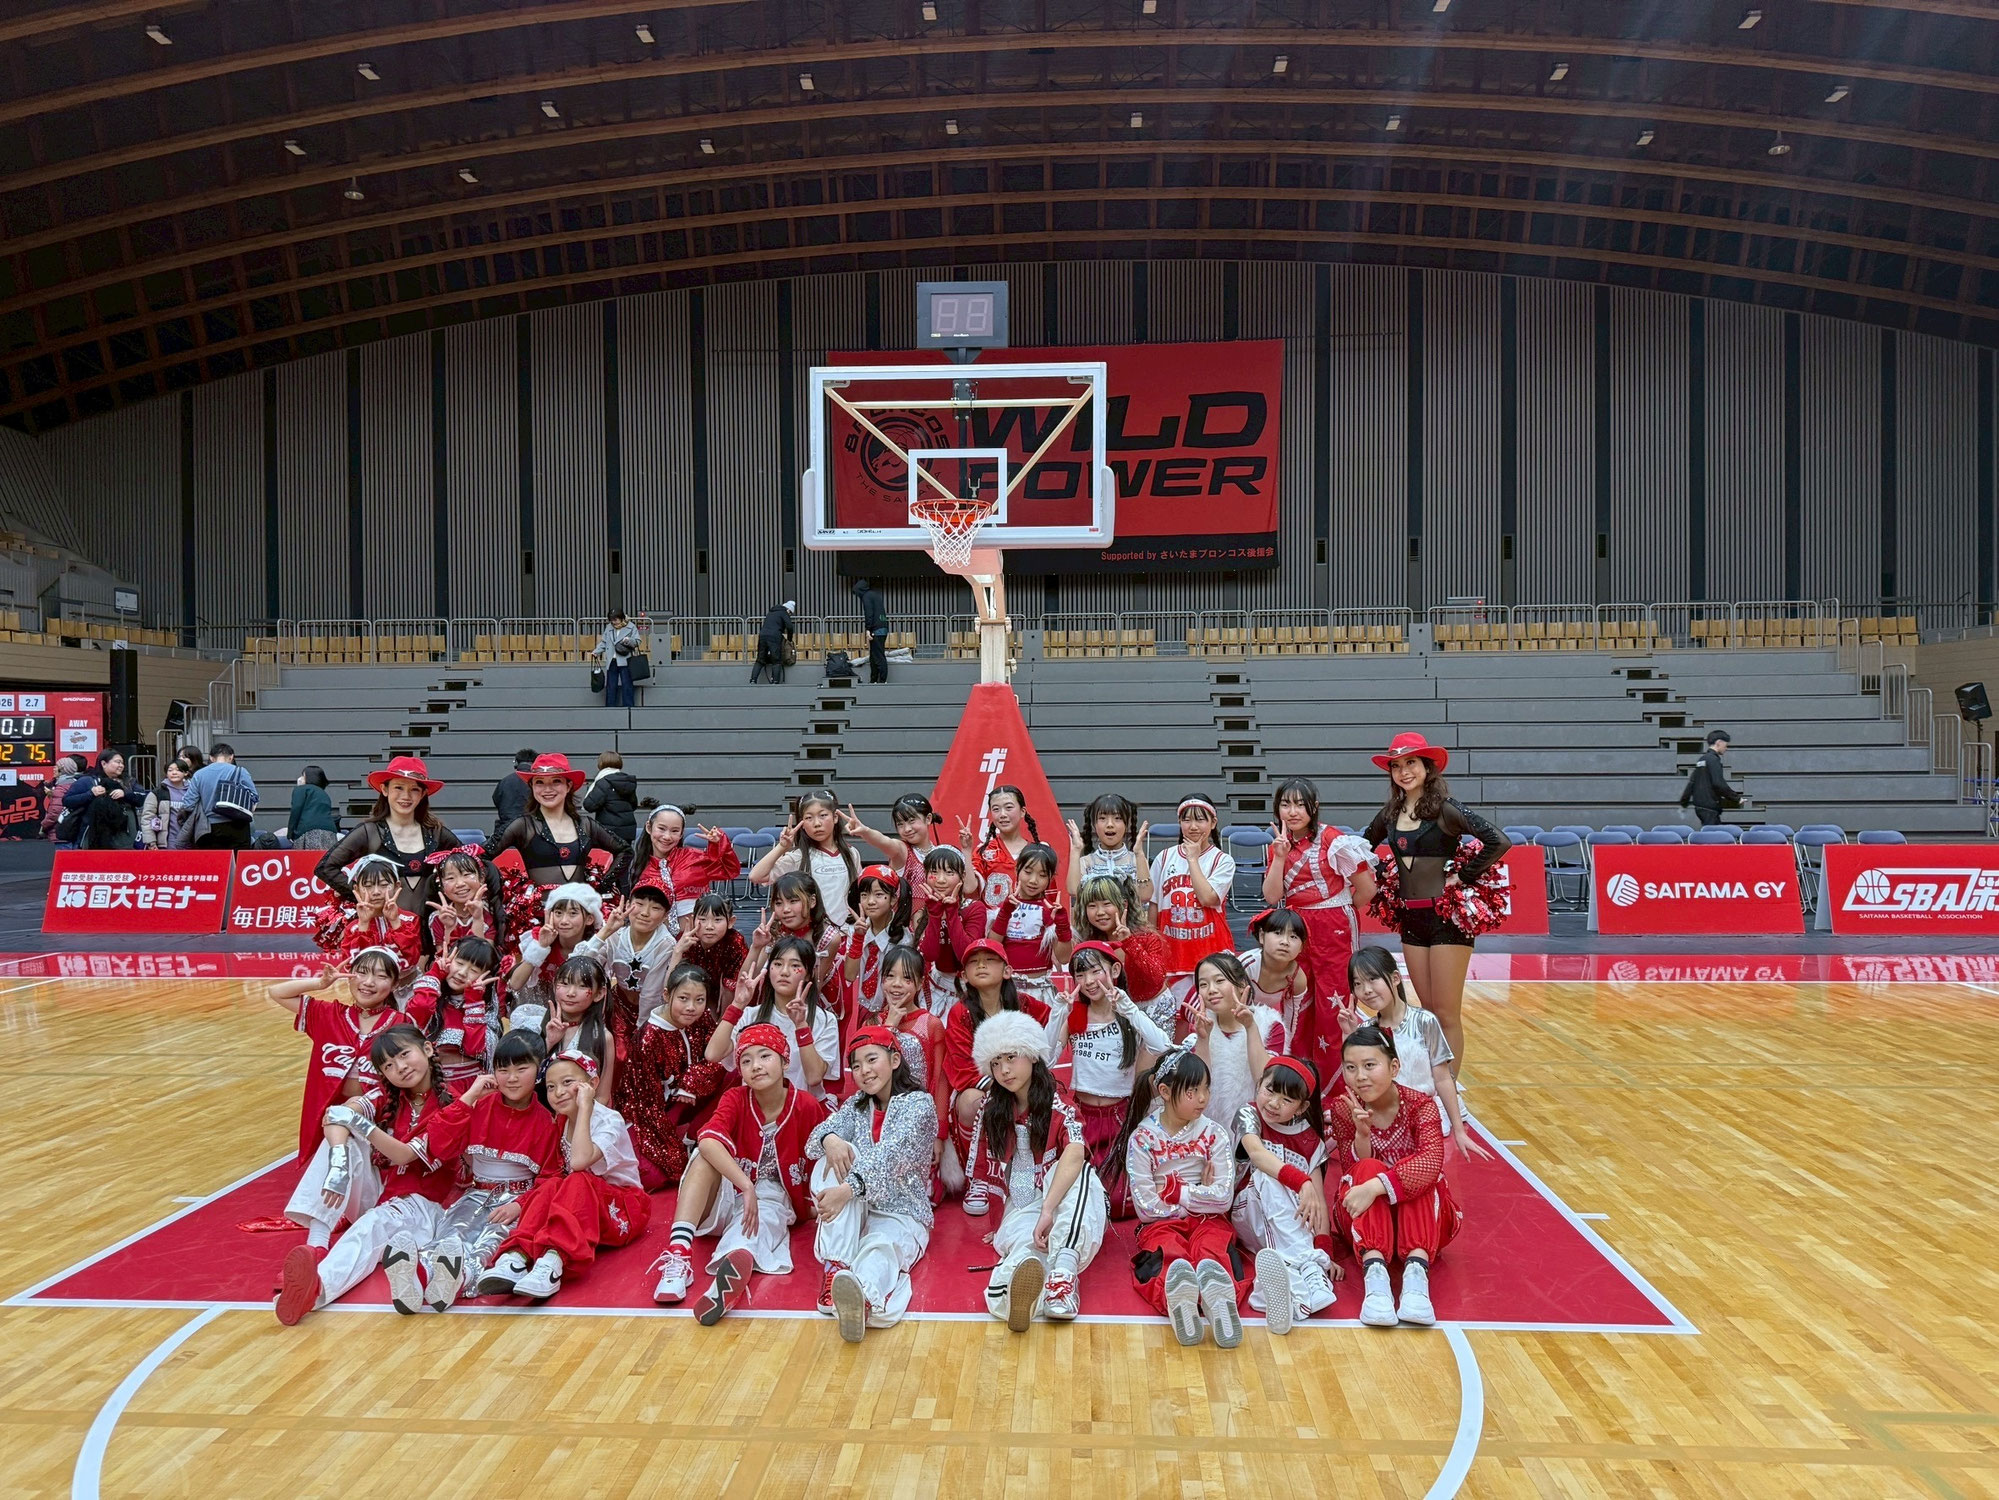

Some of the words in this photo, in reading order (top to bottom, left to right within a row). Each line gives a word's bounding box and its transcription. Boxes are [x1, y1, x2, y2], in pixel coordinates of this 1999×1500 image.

[1101, 551, 1144, 562] Supported
[1146, 551, 1157, 561] by
[25, 698, 39, 707] 2.7
[69, 719, 88, 728] AWAY
[25, 744, 46, 761] 75
[19, 773, 44, 781] QUARTER
[241, 855, 292, 887] GO!
[88, 885, 217, 909] 国大セミナー
[1643, 881, 1749, 899] SAITAMA
[1753, 881, 1786, 898] GY
[1893, 883, 1961, 912] SBA
[232, 905, 317, 929] 毎日興業
[1095, 1052, 1111, 1061] FST
